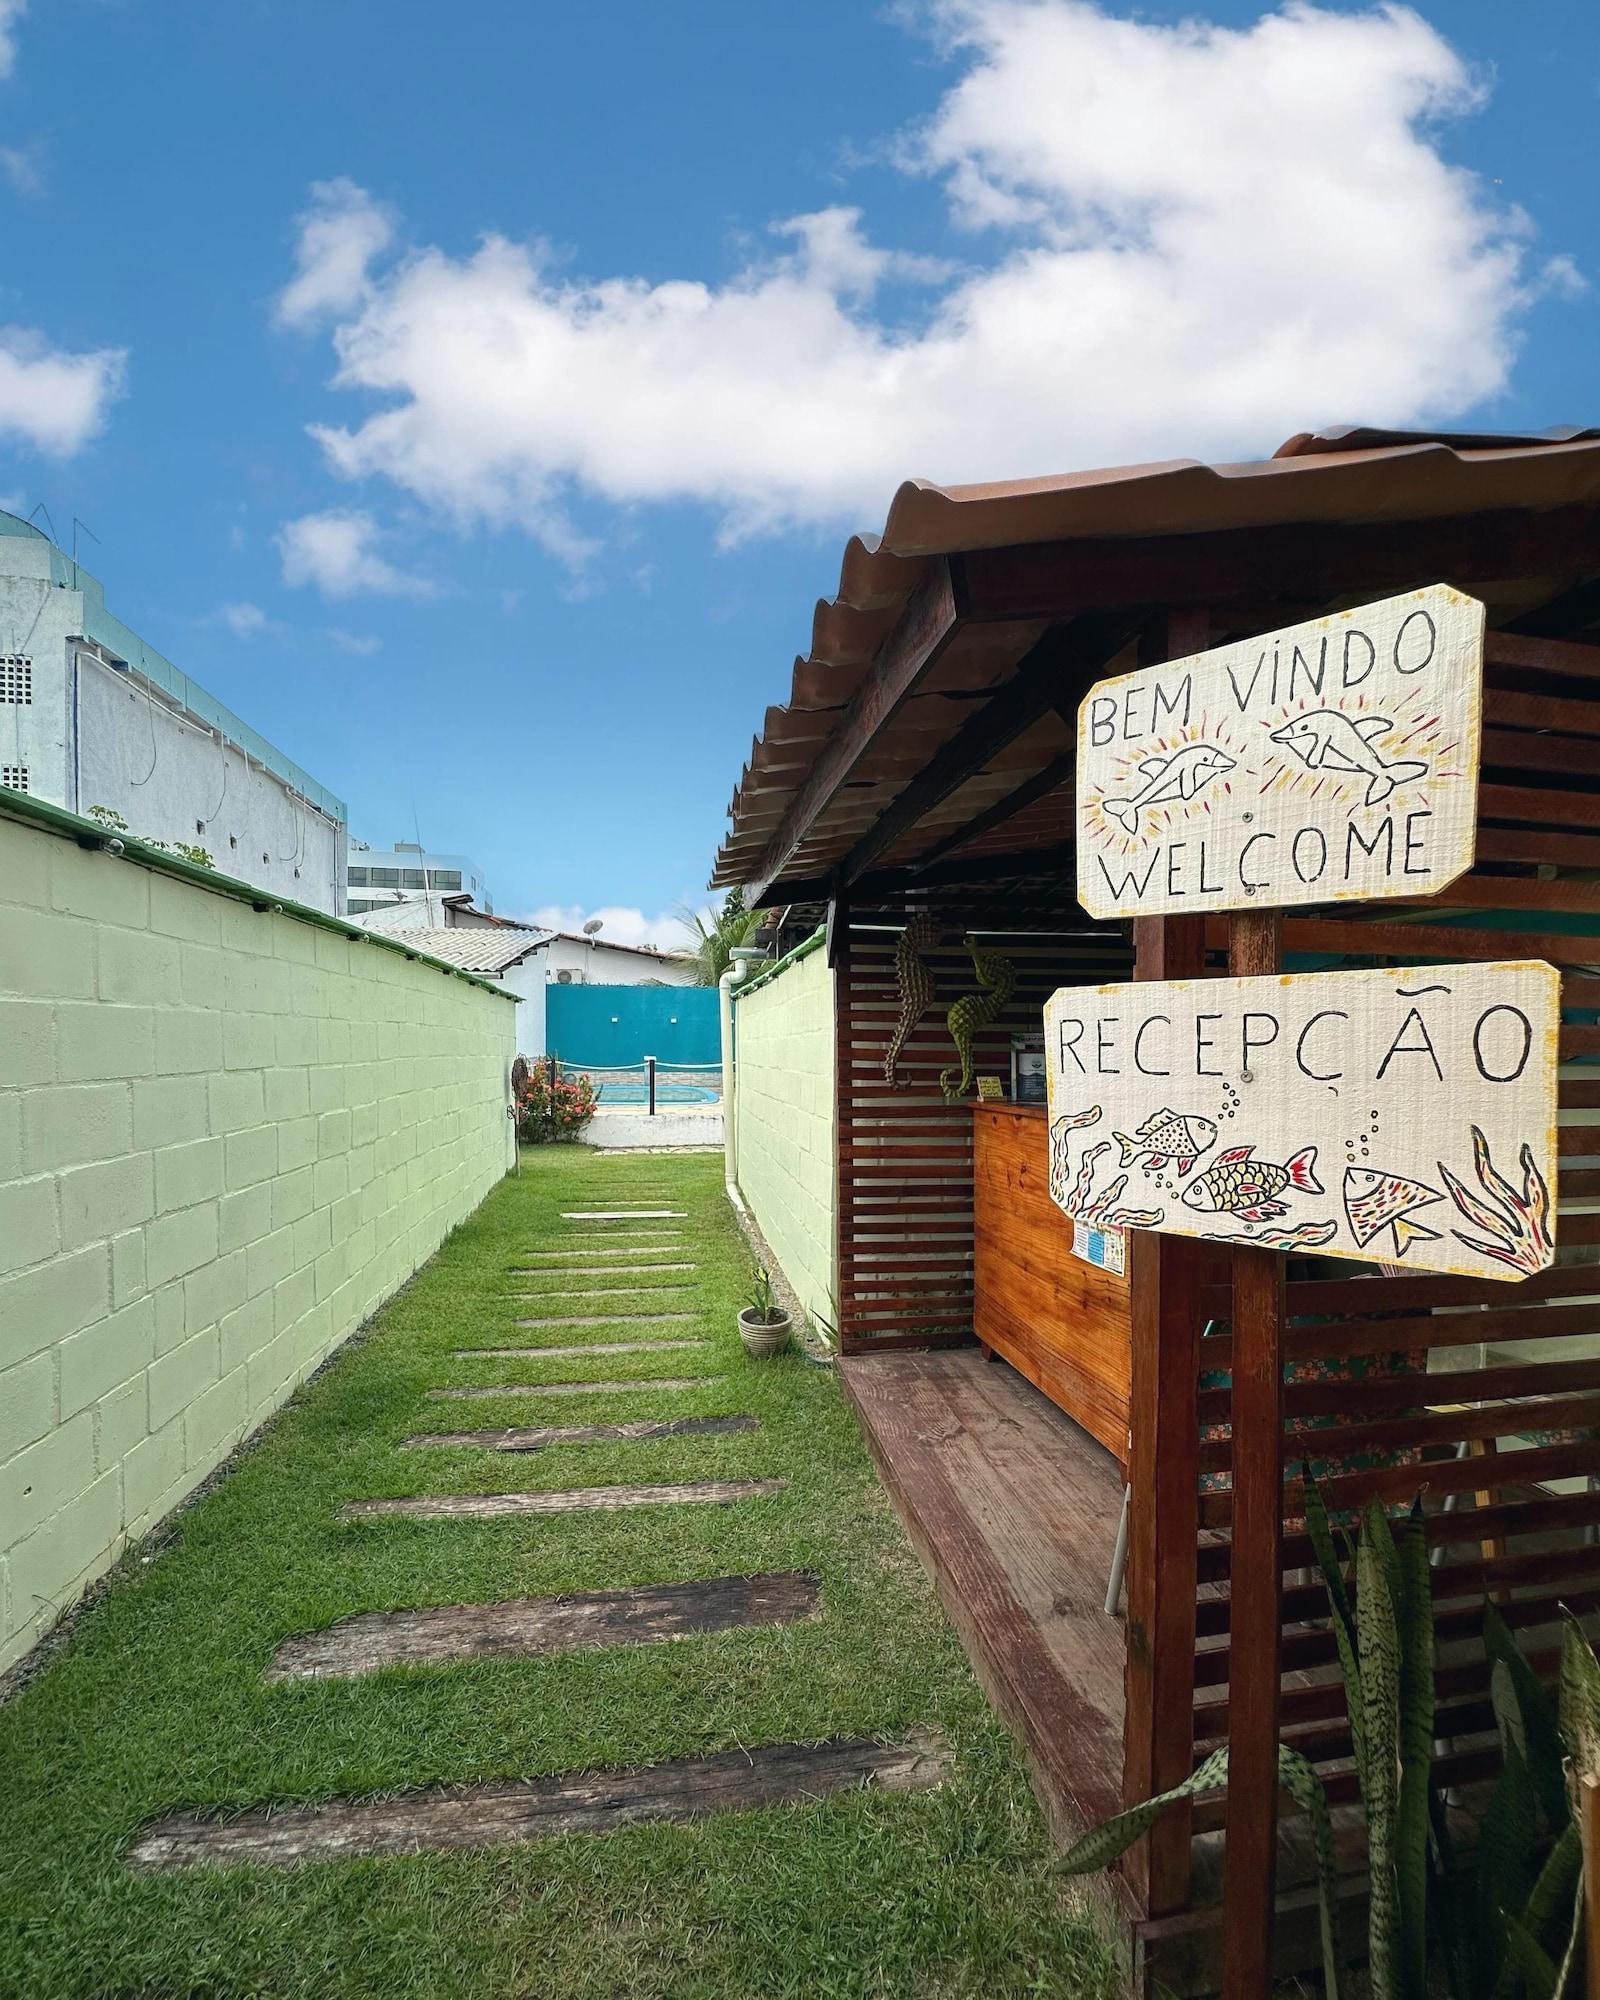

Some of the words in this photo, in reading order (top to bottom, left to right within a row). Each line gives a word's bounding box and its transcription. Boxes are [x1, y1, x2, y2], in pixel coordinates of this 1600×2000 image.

[1091, 673, 1192, 747] BEM
[1097, 811, 1433, 901] WELCOME
[1059, 984, 1532, 1096] RECEPÇÃO
